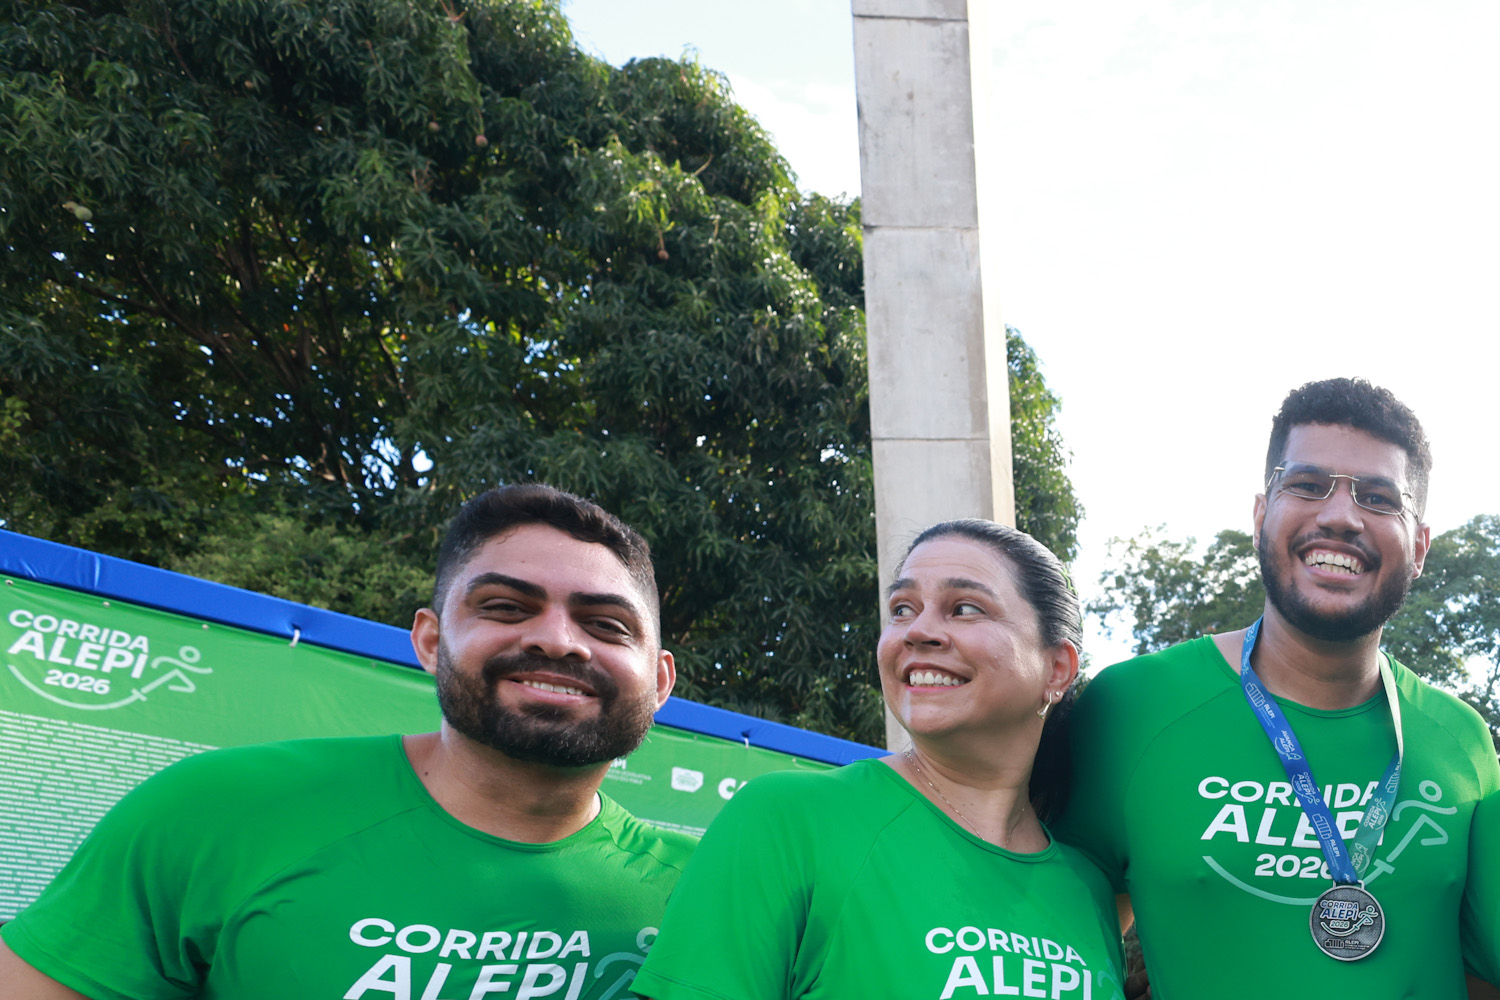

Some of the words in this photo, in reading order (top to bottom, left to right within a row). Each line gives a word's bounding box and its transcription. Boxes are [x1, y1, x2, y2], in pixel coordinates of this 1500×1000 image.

[8, 609, 149, 653] CORRIDA
[7, 630, 149, 679] ALEPI
[44, 669, 111, 695] 2026
[1198, 776, 1380, 809] CORIDA
[1297, 773, 1312, 796] ALEPI
[1368, 805, 1383, 830] ALEPI
[1330, 839, 1341, 857] ALEPI
[1320, 908, 1358, 920] ALEPI
[1321, 900, 1358, 910] CORRIDA
[1330, 920, 1350, 929] 2026
[349, 918, 590, 960] CORRIDA
[925, 926, 1087, 966] CORRIDA
